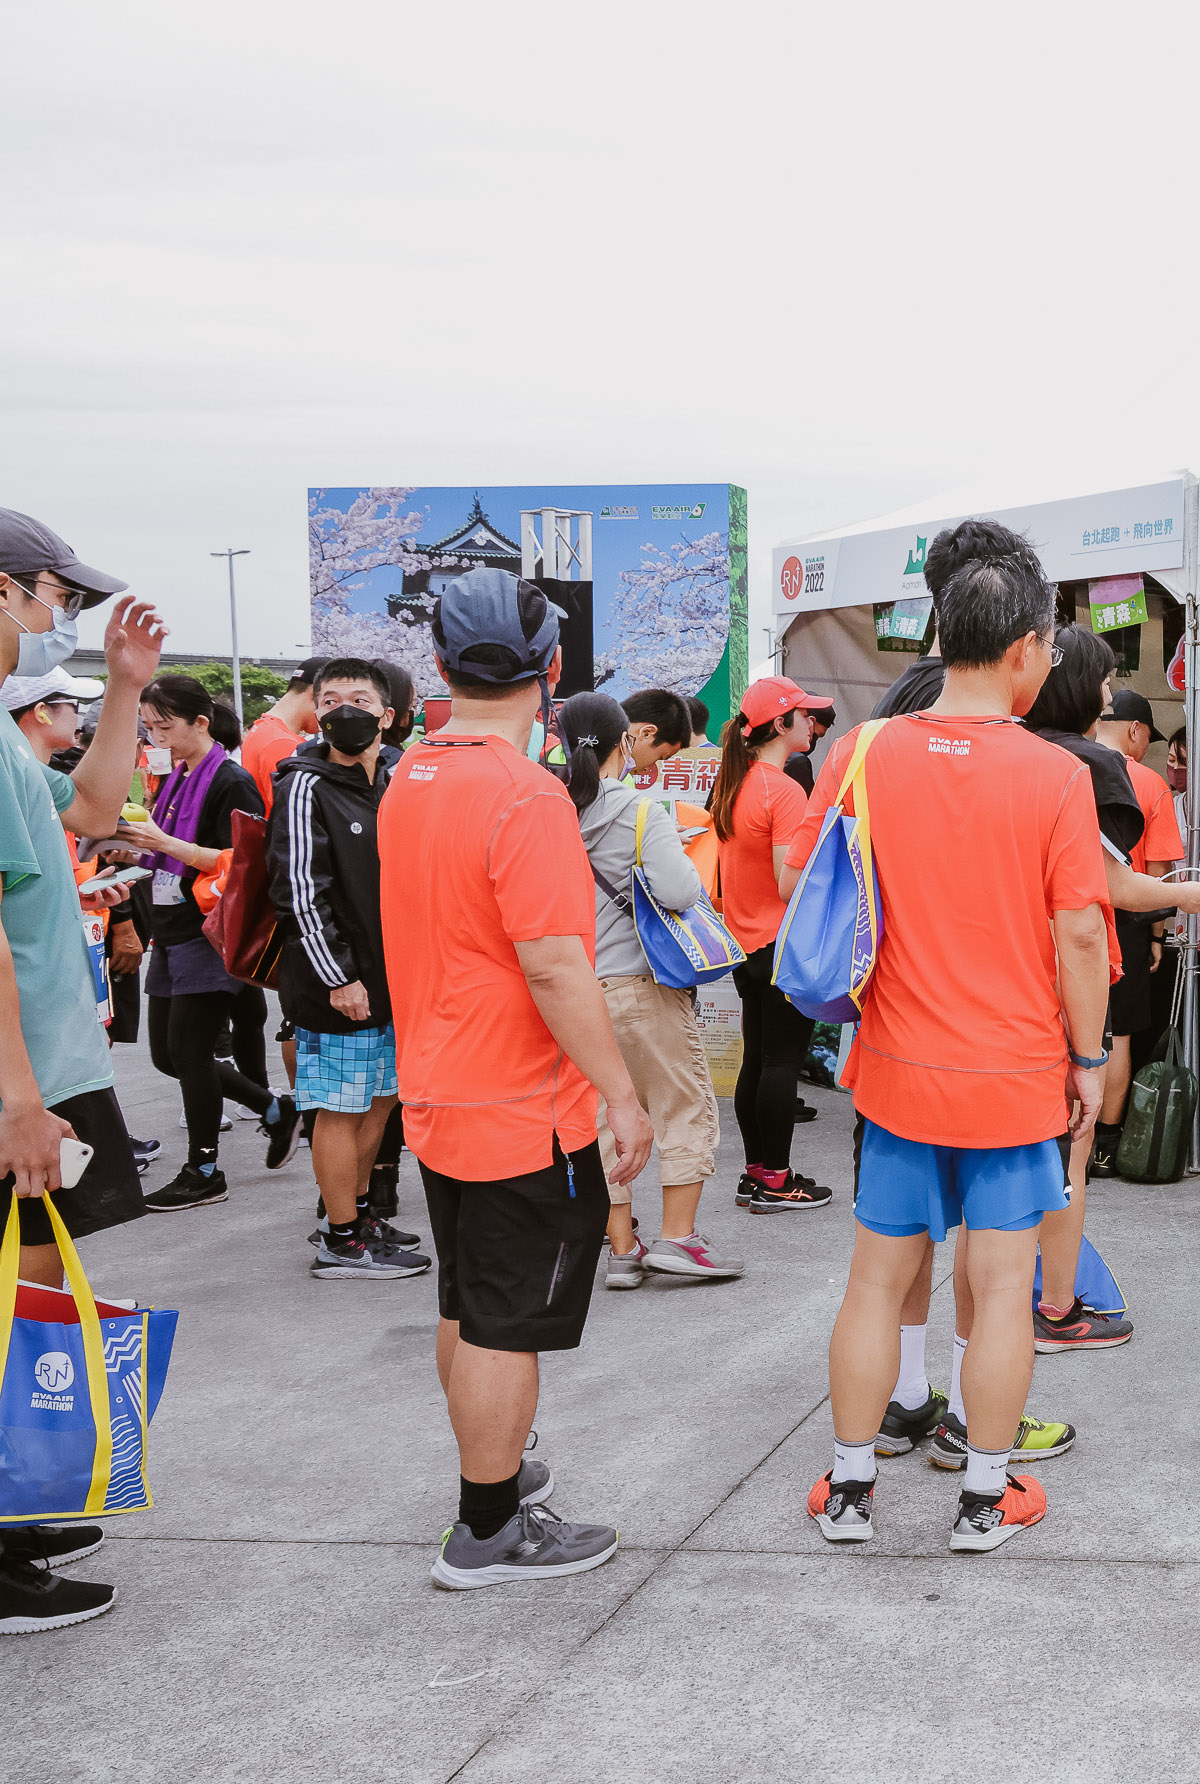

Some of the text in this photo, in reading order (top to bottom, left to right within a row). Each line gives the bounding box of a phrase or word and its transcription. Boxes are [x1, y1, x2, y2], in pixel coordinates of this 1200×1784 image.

[1082, 518, 1173, 547] 台北起跑 飛向世界
[805, 563, 825, 573] MARATHON
[804, 571, 825, 594] 2022
[1102, 602, 1131, 628] 青森
[898, 616, 918, 637] 青森
[929, 736, 951, 745] EVA
[928, 743, 970, 756] MARATHON
[30, 1398, 74, 1411] MARATHON
[32, 1392, 51, 1400] EVA
[944, 1431, 969, 1452] Reebo
